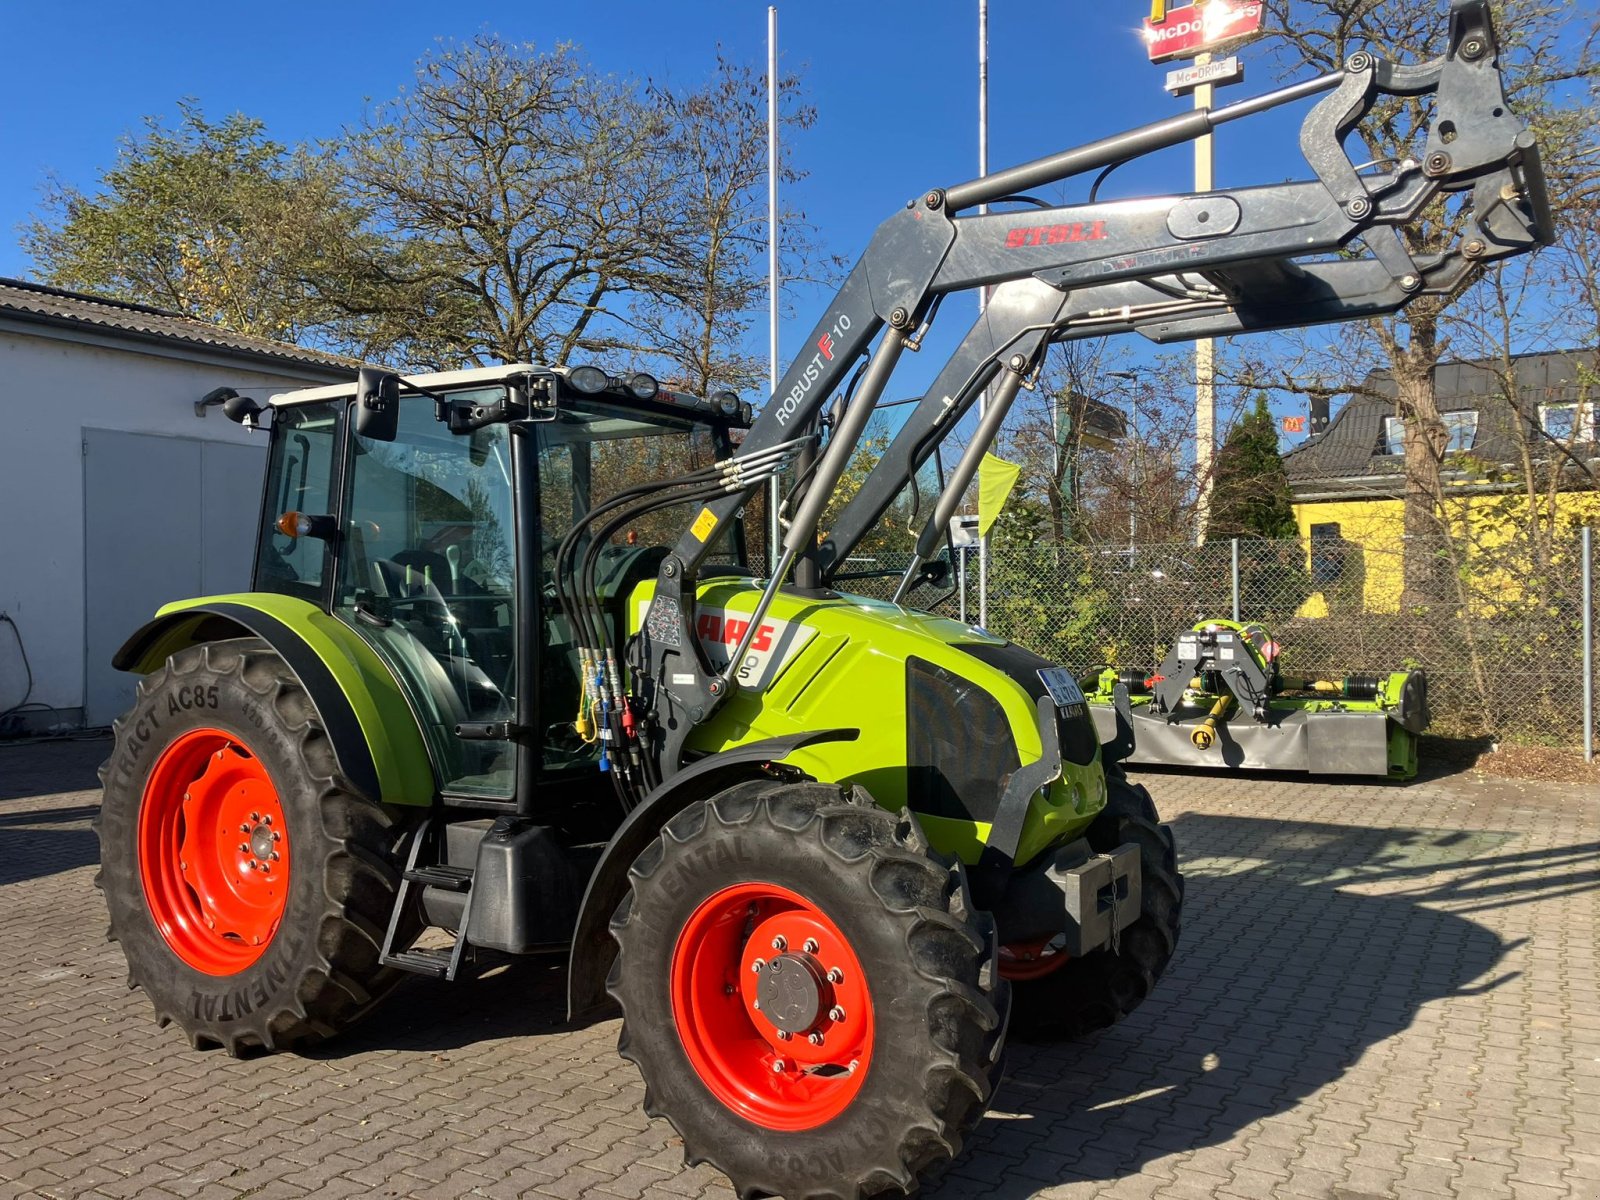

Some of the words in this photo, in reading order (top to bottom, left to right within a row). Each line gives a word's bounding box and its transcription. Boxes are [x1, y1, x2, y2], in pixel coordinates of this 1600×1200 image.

[1005, 220, 1108, 248] STOLL
[774, 352, 825, 427] ROBUST
[817, 331, 835, 361] F
[833, 314, 852, 338] 10
[697, 614, 775, 652] AAS
[167, 684, 220, 718] AC85
